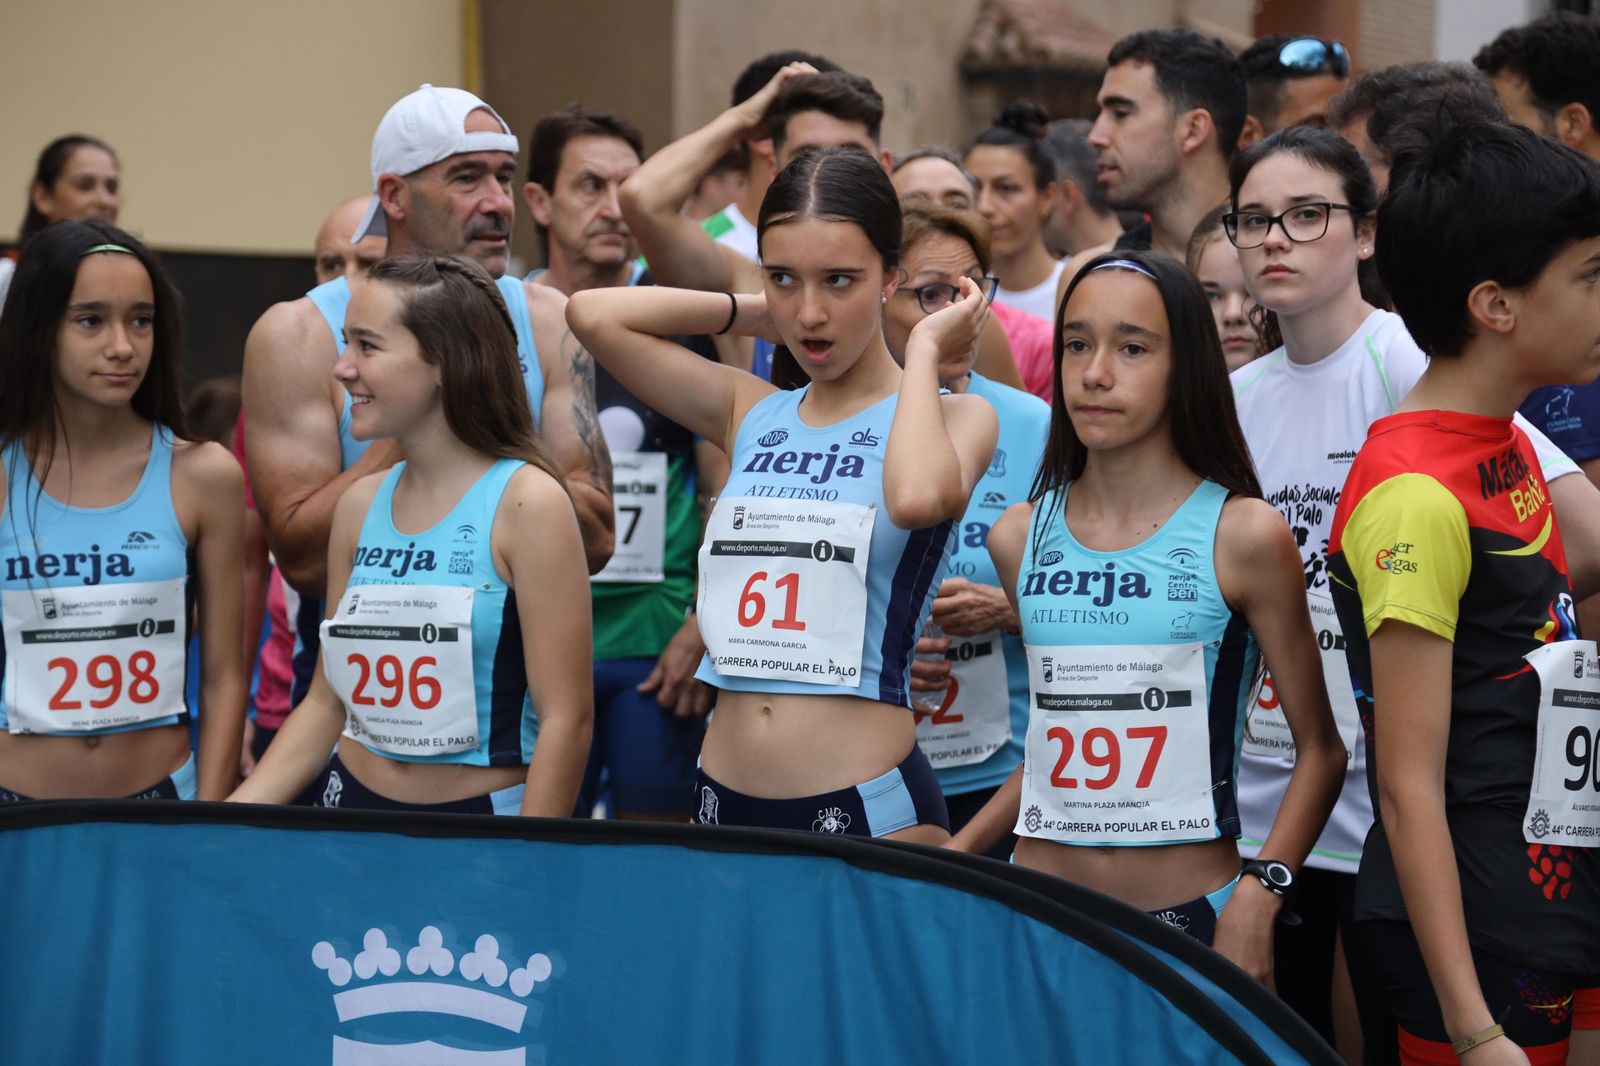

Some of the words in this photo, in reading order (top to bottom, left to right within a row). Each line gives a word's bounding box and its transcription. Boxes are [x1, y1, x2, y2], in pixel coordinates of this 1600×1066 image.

[759, 430, 789, 447] TROPS
[743, 444, 865, 484] nerja
[744, 484, 839, 502] ATLETISMO
[1302, 483, 1342, 506] Sociale
[747, 512, 795, 523] Ayuntamiento
[797, 514, 806, 523] de
[808, 513, 836, 526] Málaga
[1296, 503, 1323, 526] Palo
[721, 543, 787, 555] www.deporte.malaga.eu
[6, 544, 135, 585] nerja
[1040, 551, 1063, 566] TROPS
[1022, 562, 1152, 607] nerja
[1168, 573, 1191, 583] nerja
[1168, 581, 1198, 589] Centro
[738, 571, 806, 631] 61
[1168, 588, 1198, 600] aen
[1031, 608, 1129, 625] ATLETISMO
[1311, 604, 1337, 615] Málaga
[728, 637, 745, 645] MARIA
[746, 638, 780, 648] CARMONA
[781, 641, 807, 650] GARCIA
[718, 656, 758, 668] CARRERA
[761, 659, 809, 673] POPULAR
[812, 664, 825, 674] EL
[828, 665, 857, 677] PALO
[1057, 662, 1114, 674] Ayuntamiento
[1117, 662, 1127, 672] de
[1130, 661, 1163, 673] Málaga
[47, 650, 160, 711] 298
[347, 653, 442, 710] 296
[1077, 674, 1099, 682] Deporte
[394, 736, 430, 747] POPULAR
[433, 738, 445, 747] EL
[447, 735, 475, 746] PALO
[931, 747, 972, 760] POPULAR
[974, 744, 985, 754] EL
[1046, 726, 1168, 790] 297
[1056, 821, 1101, 833] CARRERA
[1105, 822, 1157, 833] POPULAR
[1161, 820, 1175, 831] EL
[1179, 818, 1210, 829] PALO
